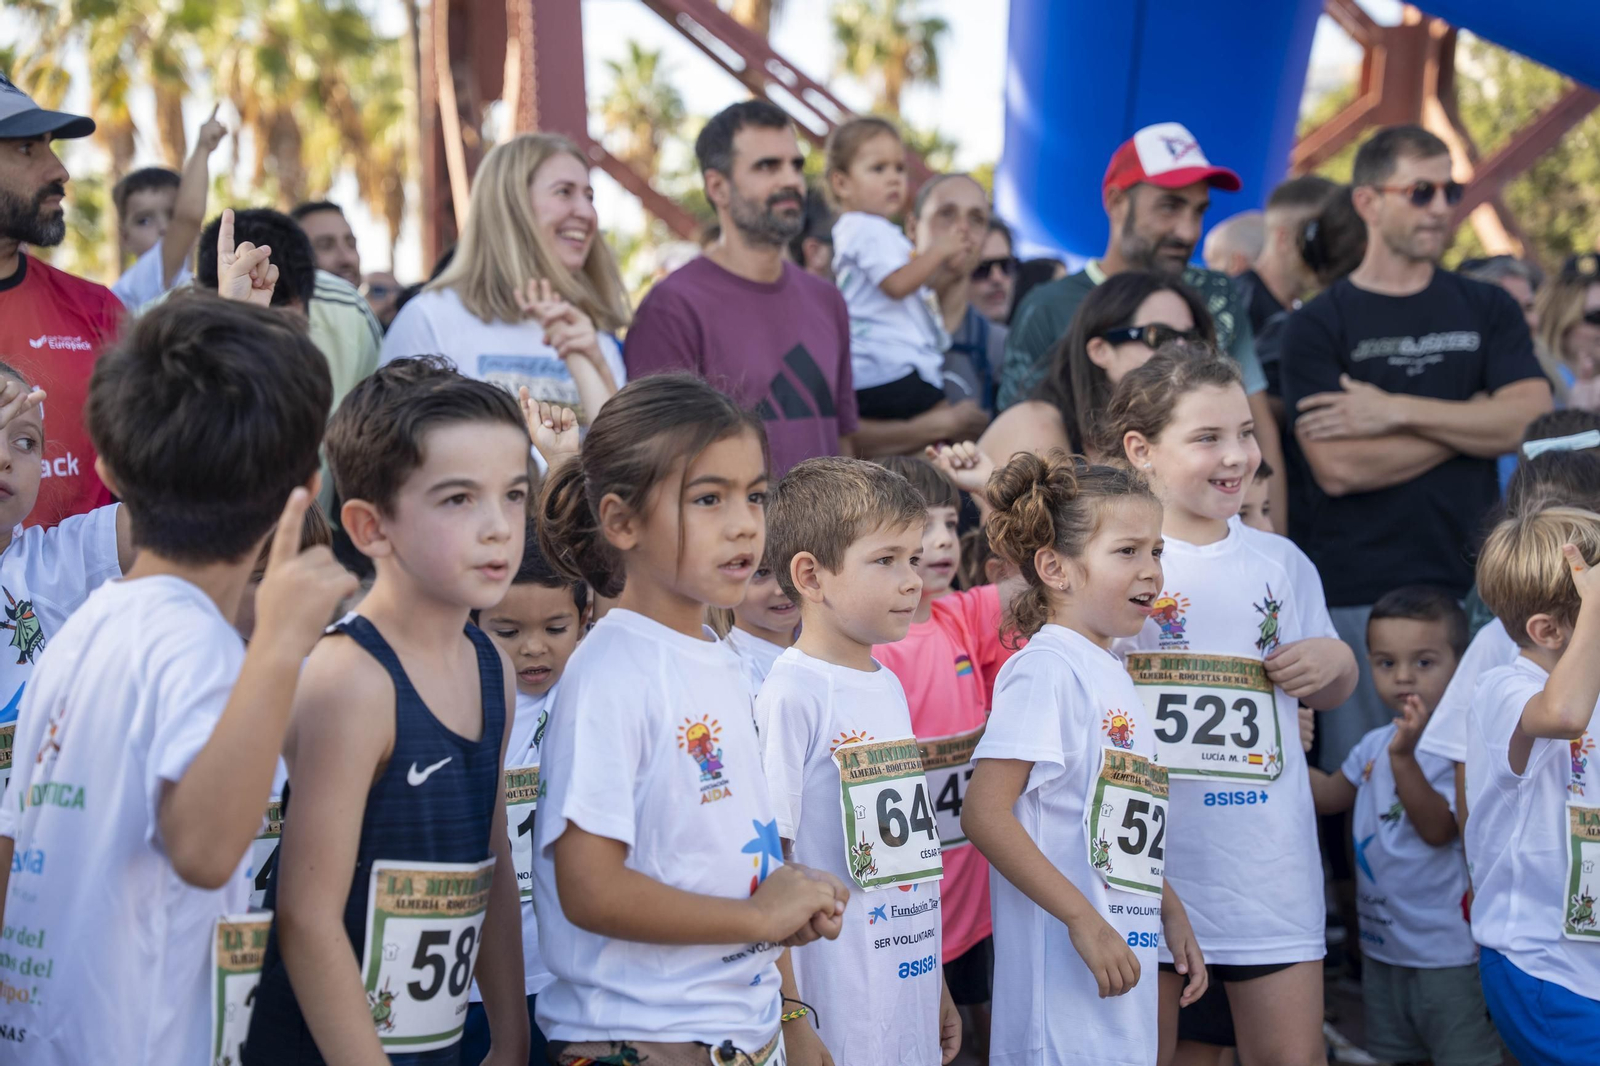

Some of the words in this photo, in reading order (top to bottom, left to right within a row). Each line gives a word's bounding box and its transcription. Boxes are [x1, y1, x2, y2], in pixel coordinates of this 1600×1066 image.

[1133, 658, 1152, 671] LA
[1160, 658, 1266, 678] MINIDESÉRTI
[1139, 672, 1172, 680] ALMERÍA
[1179, 672, 1220, 683] ROQUETAS
[1222, 675, 1233, 684] DE
[1234, 676, 1248, 684] MAR
[1154, 694, 1260, 748] 523
[842, 752, 860, 769] LA
[1111, 755, 1126, 771] LA
[1202, 752, 1226, 762] LUCÍA
[850, 765, 883, 780] ALMERÍA
[886, 761, 916, 773] ROQUETAS
[700, 786, 733, 805] AIDA
[876, 783, 941, 848] 64
[387, 875, 414, 896] LA
[394, 899, 440, 910] ALMERÍA
[891, 900, 928, 917] Fundación
[17, 926, 45, 949] del
[223, 930, 243, 950] LA
[874, 938, 891, 949] SER
[19, 957, 53, 979] del
[407, 926, 484, 1002] 58
